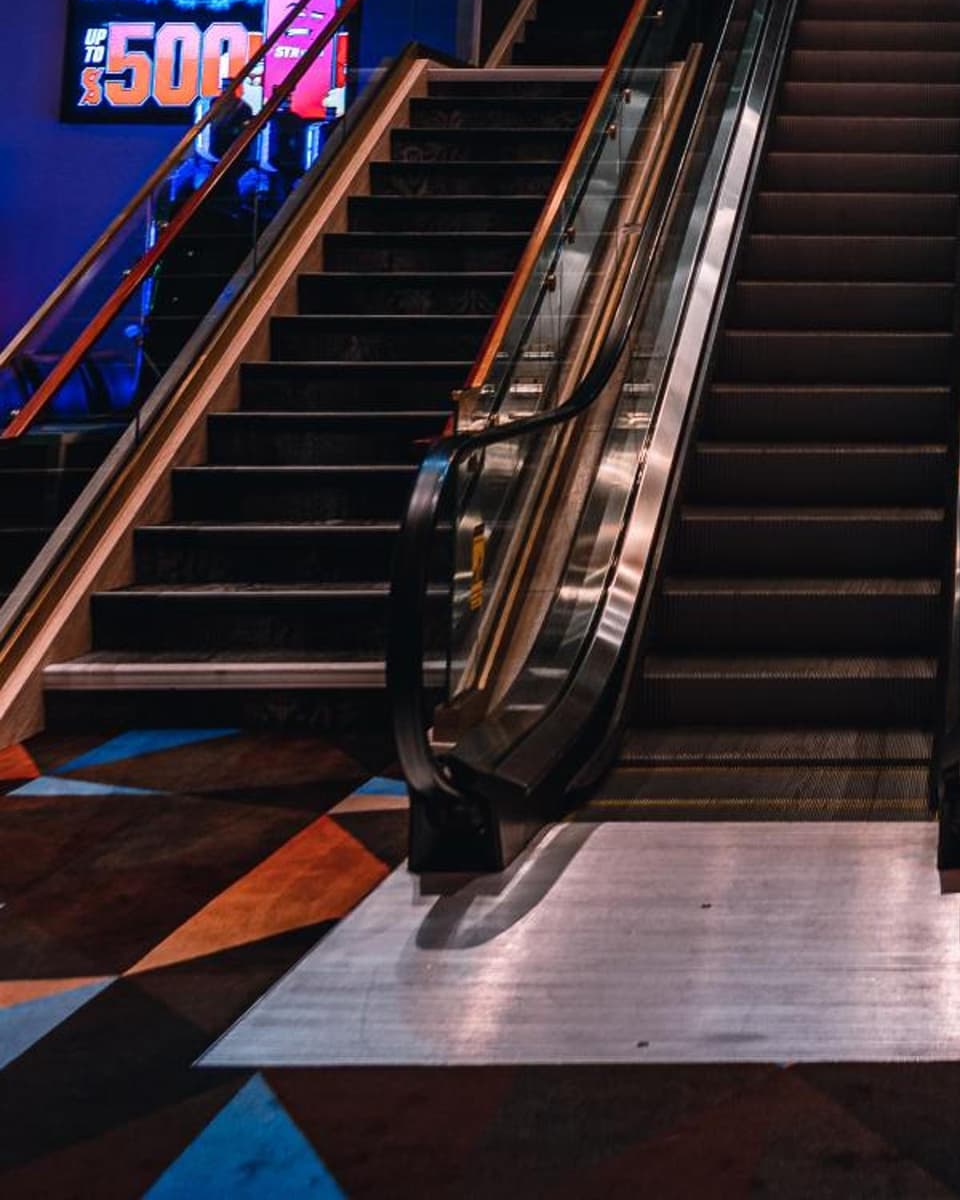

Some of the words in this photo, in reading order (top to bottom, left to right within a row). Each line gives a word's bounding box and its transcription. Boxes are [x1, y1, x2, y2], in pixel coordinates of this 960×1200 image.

[84, 28, 108, 45] UP
[84, 45, 106, 63] TO
[77, 22, 249, 107] $500
